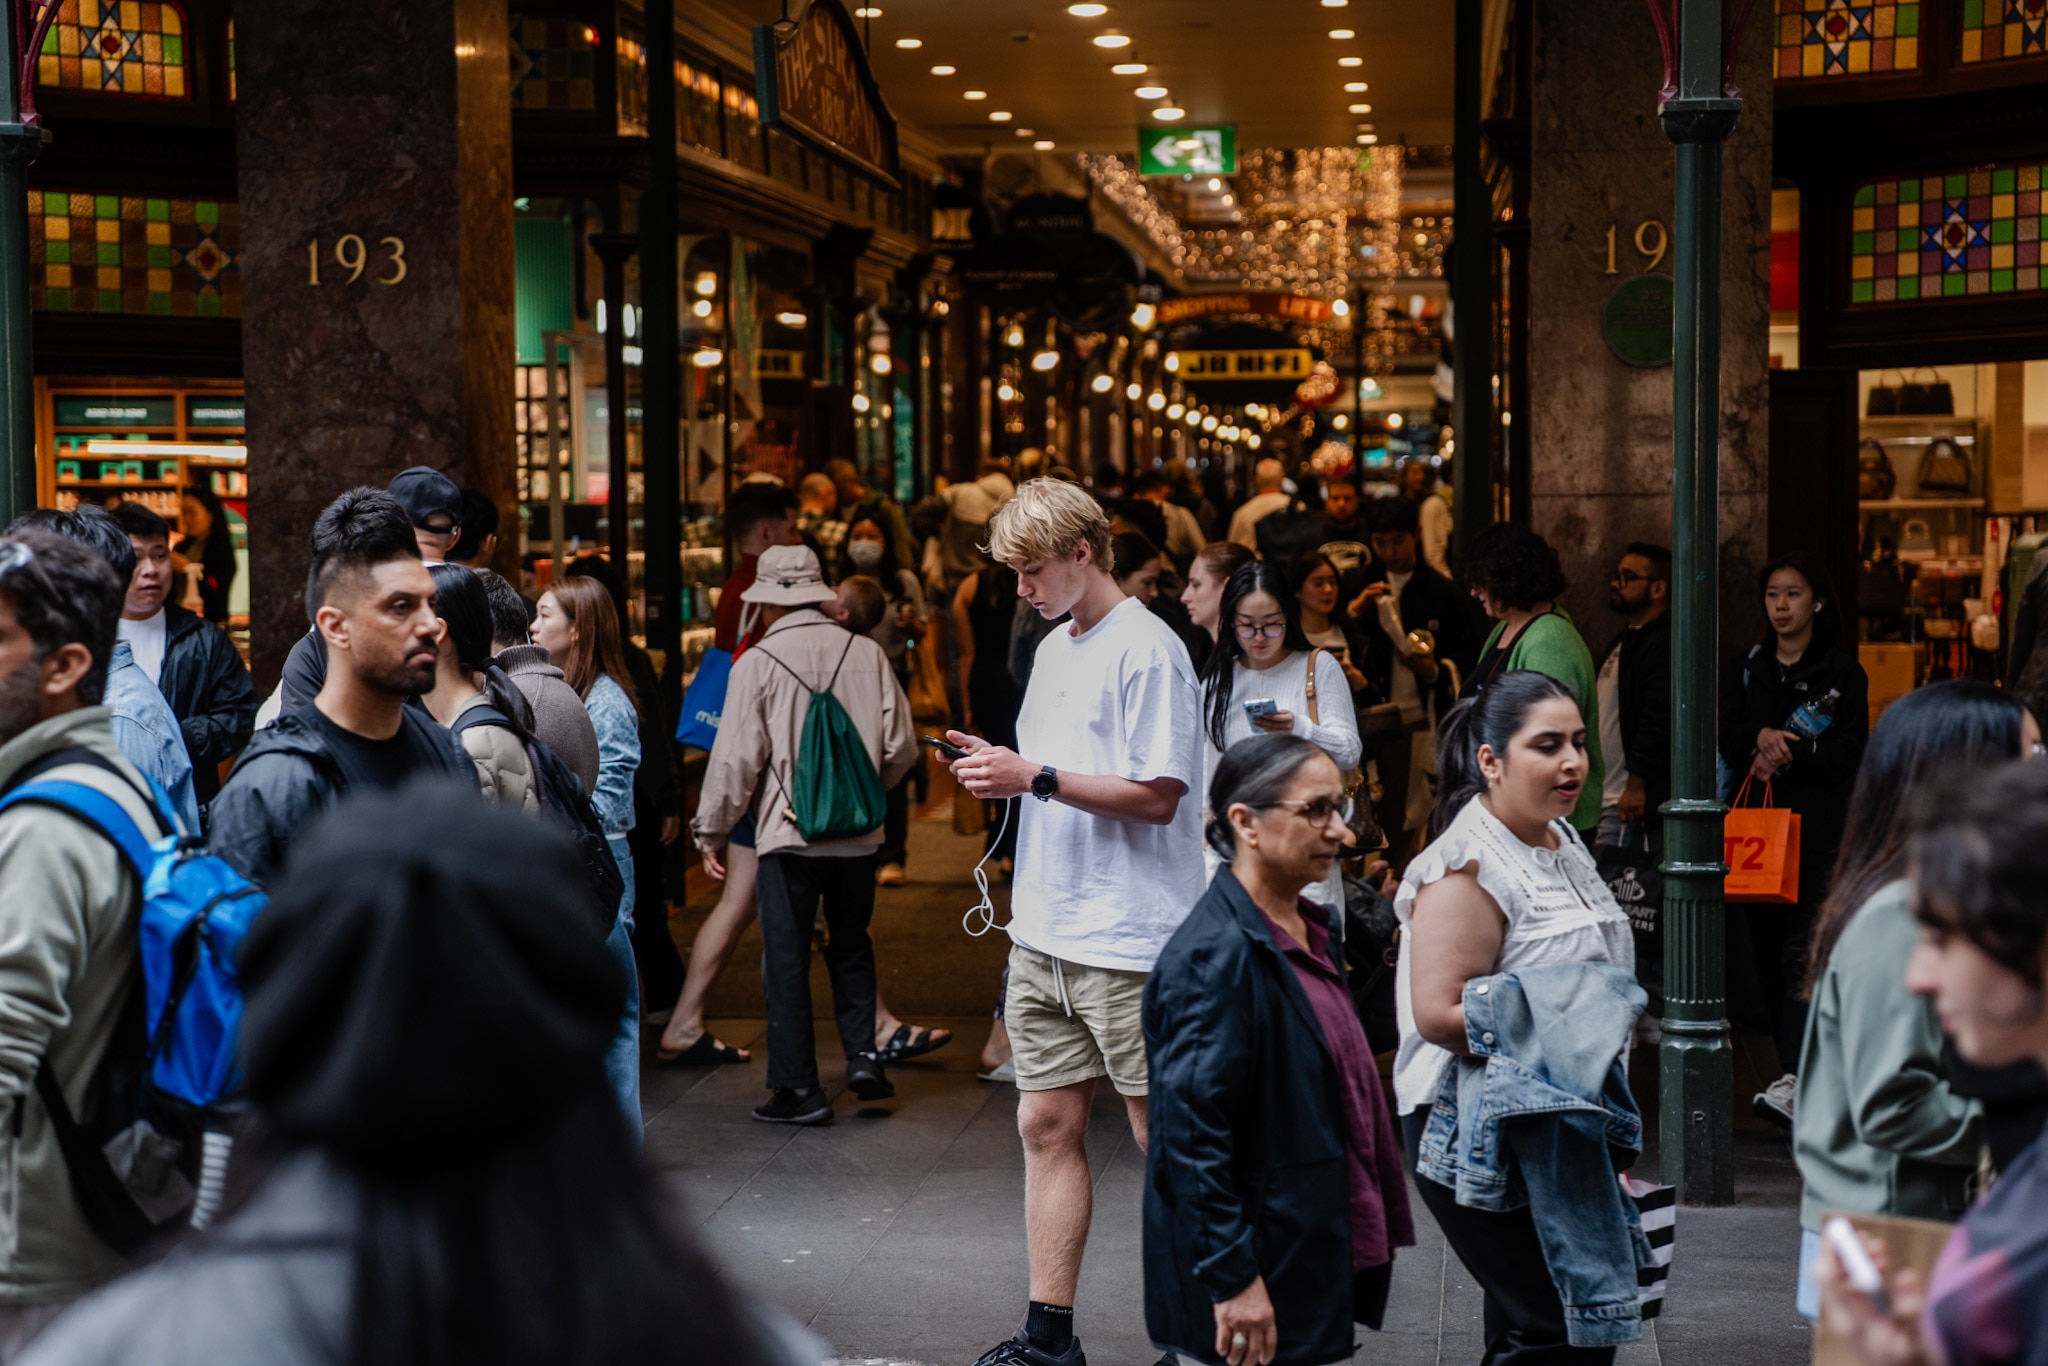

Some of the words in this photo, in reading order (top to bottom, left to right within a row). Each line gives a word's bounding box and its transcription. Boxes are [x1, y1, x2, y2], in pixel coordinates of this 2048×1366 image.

[778, 28, 812, 111] THE
[307, 232, 409, 287] 193
[1602, 219, 1669, 275] 19
[1278, 295, 1328, 320] LIFT
[1187, 356, 1227, 373] JB
[1237, 355, 1300, 372] HI-FI
[1724, 836, 1766, 870] T2
[1691, 1110, 1706, 1128] P
